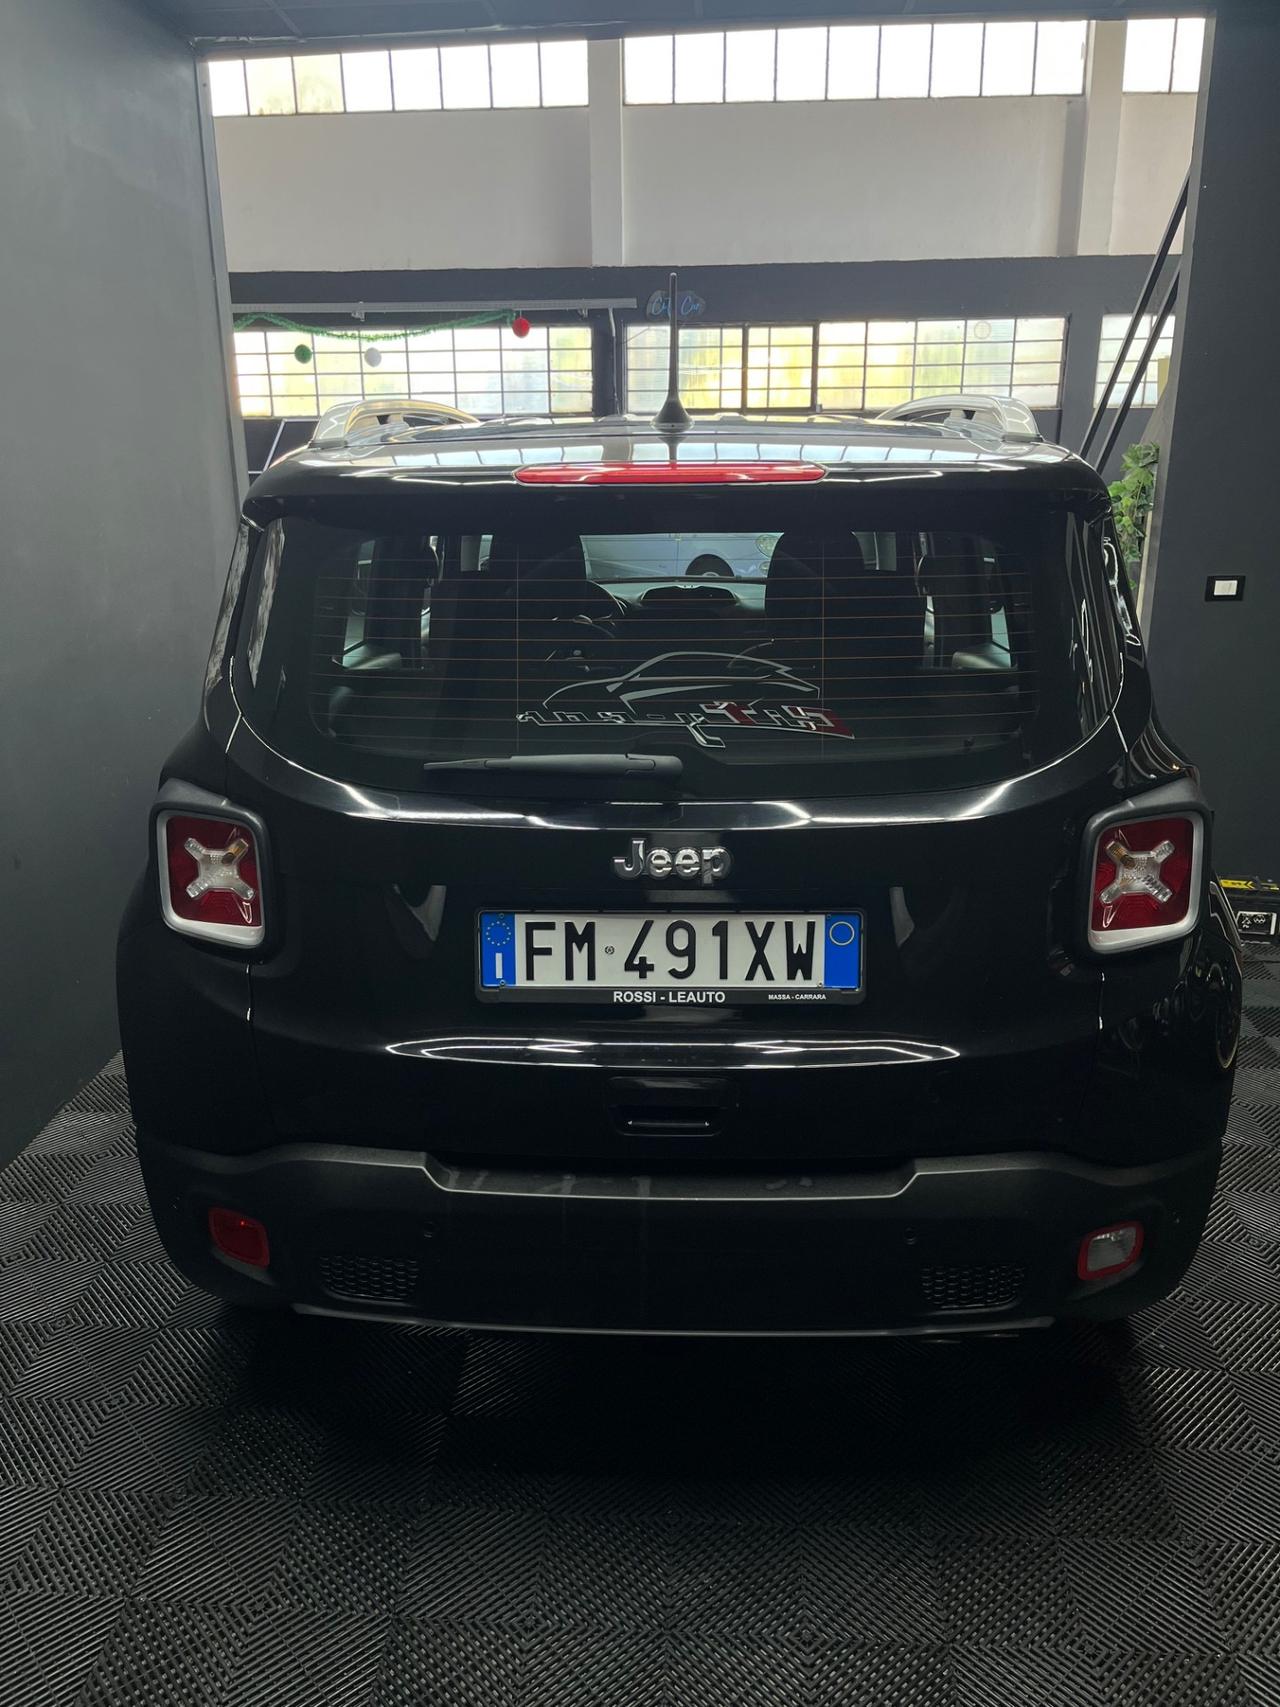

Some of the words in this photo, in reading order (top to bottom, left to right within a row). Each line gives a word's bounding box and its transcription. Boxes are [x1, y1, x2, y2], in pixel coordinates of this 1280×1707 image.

[612, 838, 733, 886] Jeep
[524, 921, 596, 981] FM
[623, 919, 816, 981] 491XW
[613, 991, 656, 1003] ROSSI
[669, 991, 726, 1003] LEAUTO
